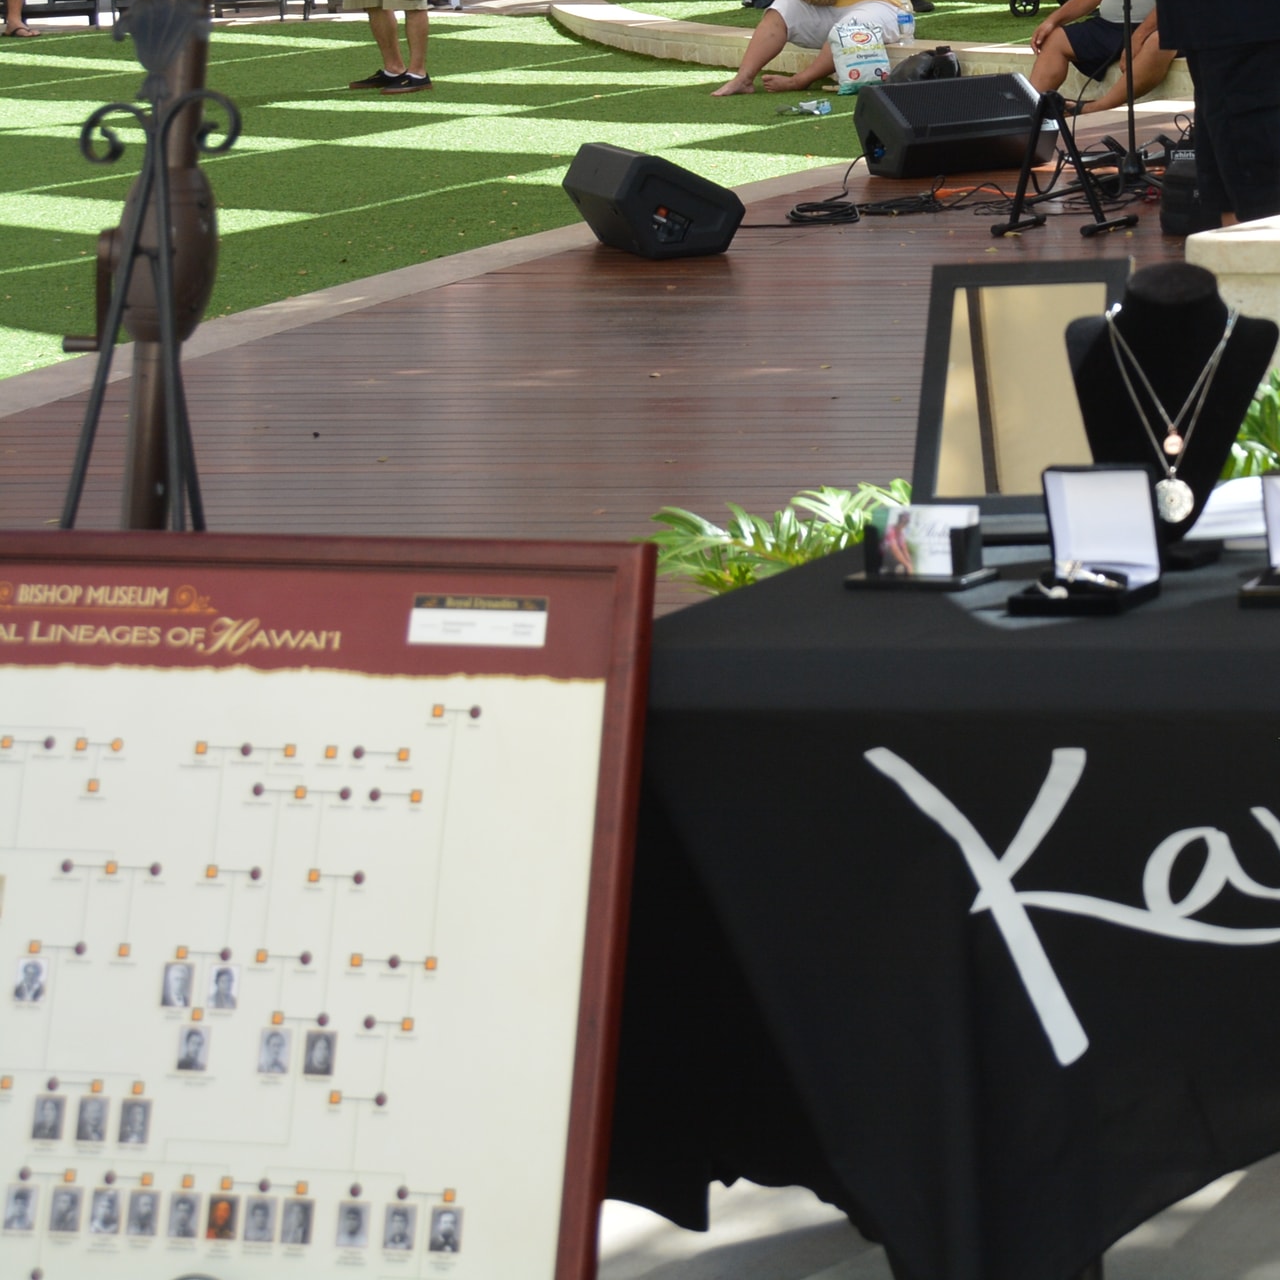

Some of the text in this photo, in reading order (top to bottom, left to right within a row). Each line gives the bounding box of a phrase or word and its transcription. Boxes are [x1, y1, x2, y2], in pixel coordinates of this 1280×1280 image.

[18, 583, 169, 607] BISHOP MUSEUM
[30, 620, 161, 647] LINEAGES
